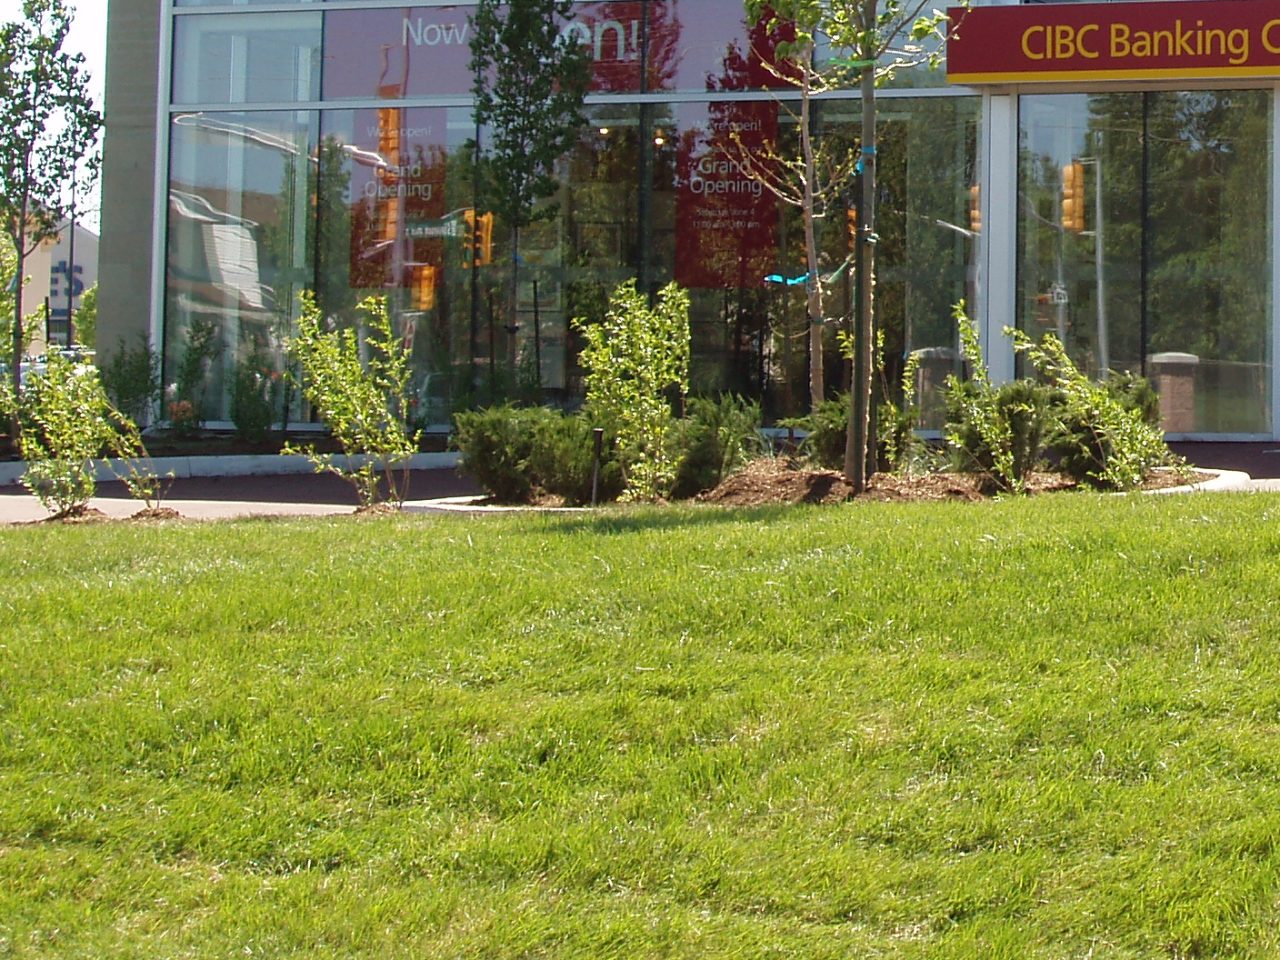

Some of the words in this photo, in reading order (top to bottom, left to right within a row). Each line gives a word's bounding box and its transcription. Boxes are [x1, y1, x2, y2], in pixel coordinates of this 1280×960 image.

[402, 17, 471, 47] Now
[1021, 24, 1100, 60] CIBC
[1110, 19, 1251, 64] Banking
[690, 177, 763, 198] Opening
